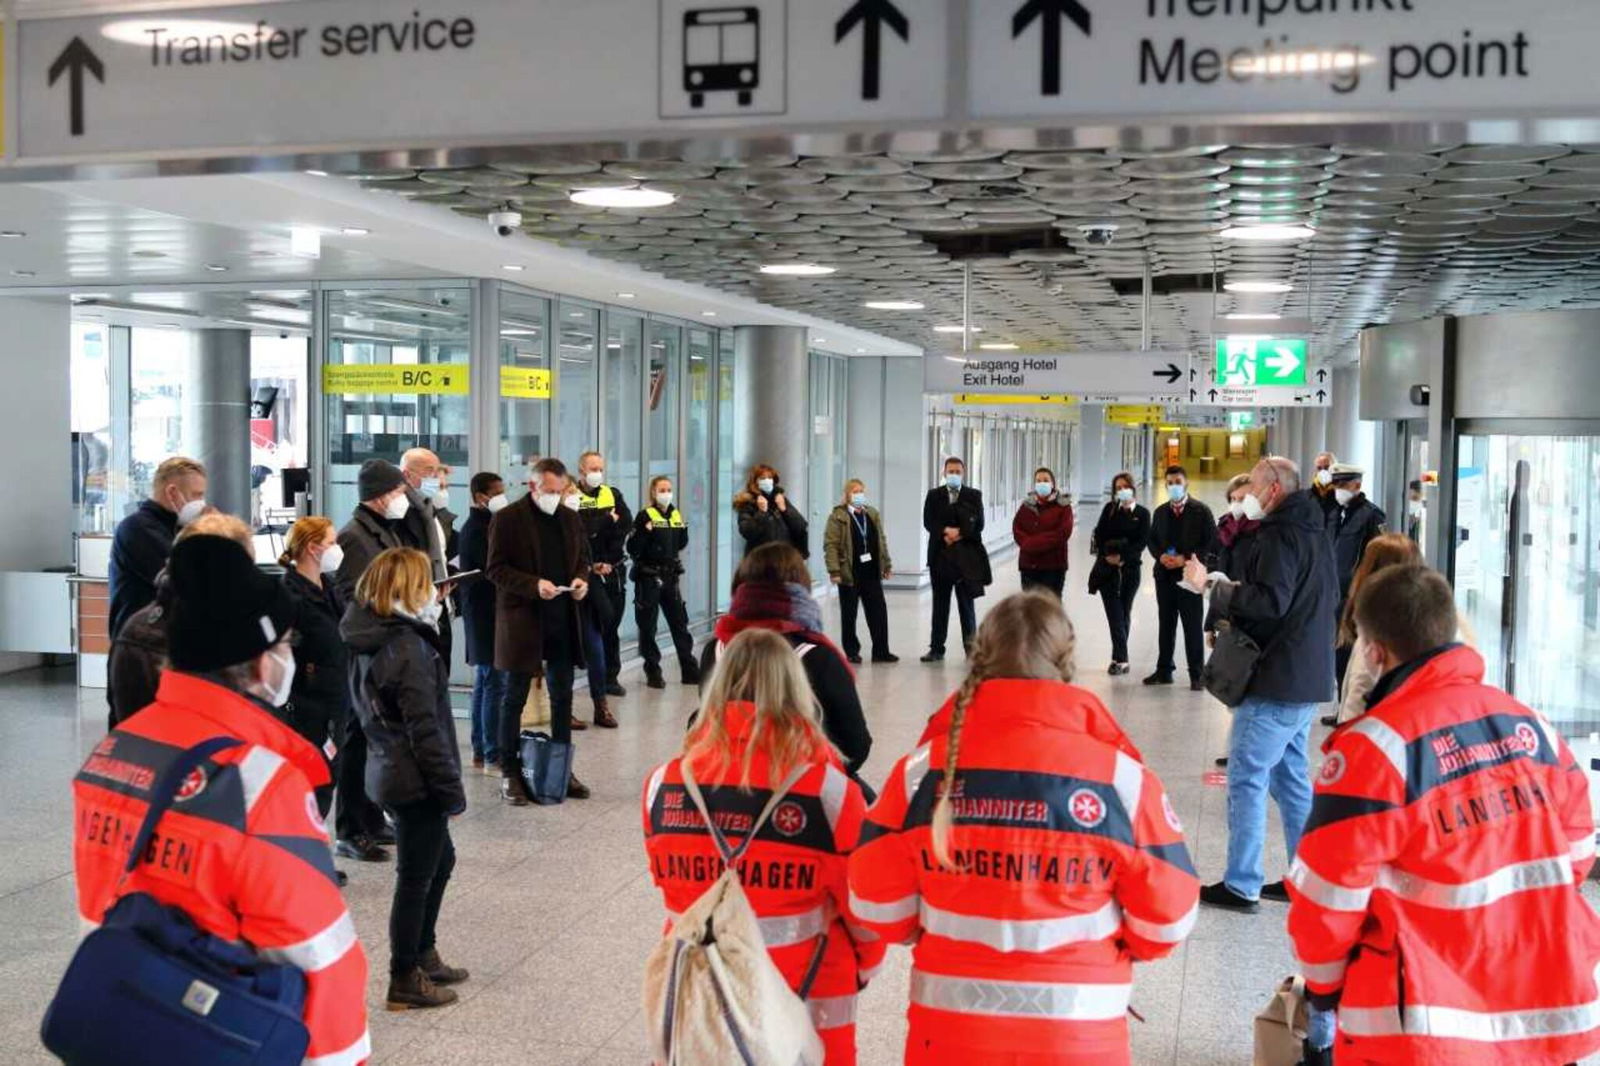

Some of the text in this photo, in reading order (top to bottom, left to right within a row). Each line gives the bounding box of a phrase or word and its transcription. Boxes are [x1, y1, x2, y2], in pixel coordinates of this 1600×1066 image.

[145, 11, 476, 67] Transfer service
[1387, 29, 1529, 91] point
[1023, 358, 1058, 371] Hotel
[402, 370, 432, 387] B/C
[963, 373, 1025, 386] Exit Hotel
[921, 848, 1113, 884] LNGENHAGEN
